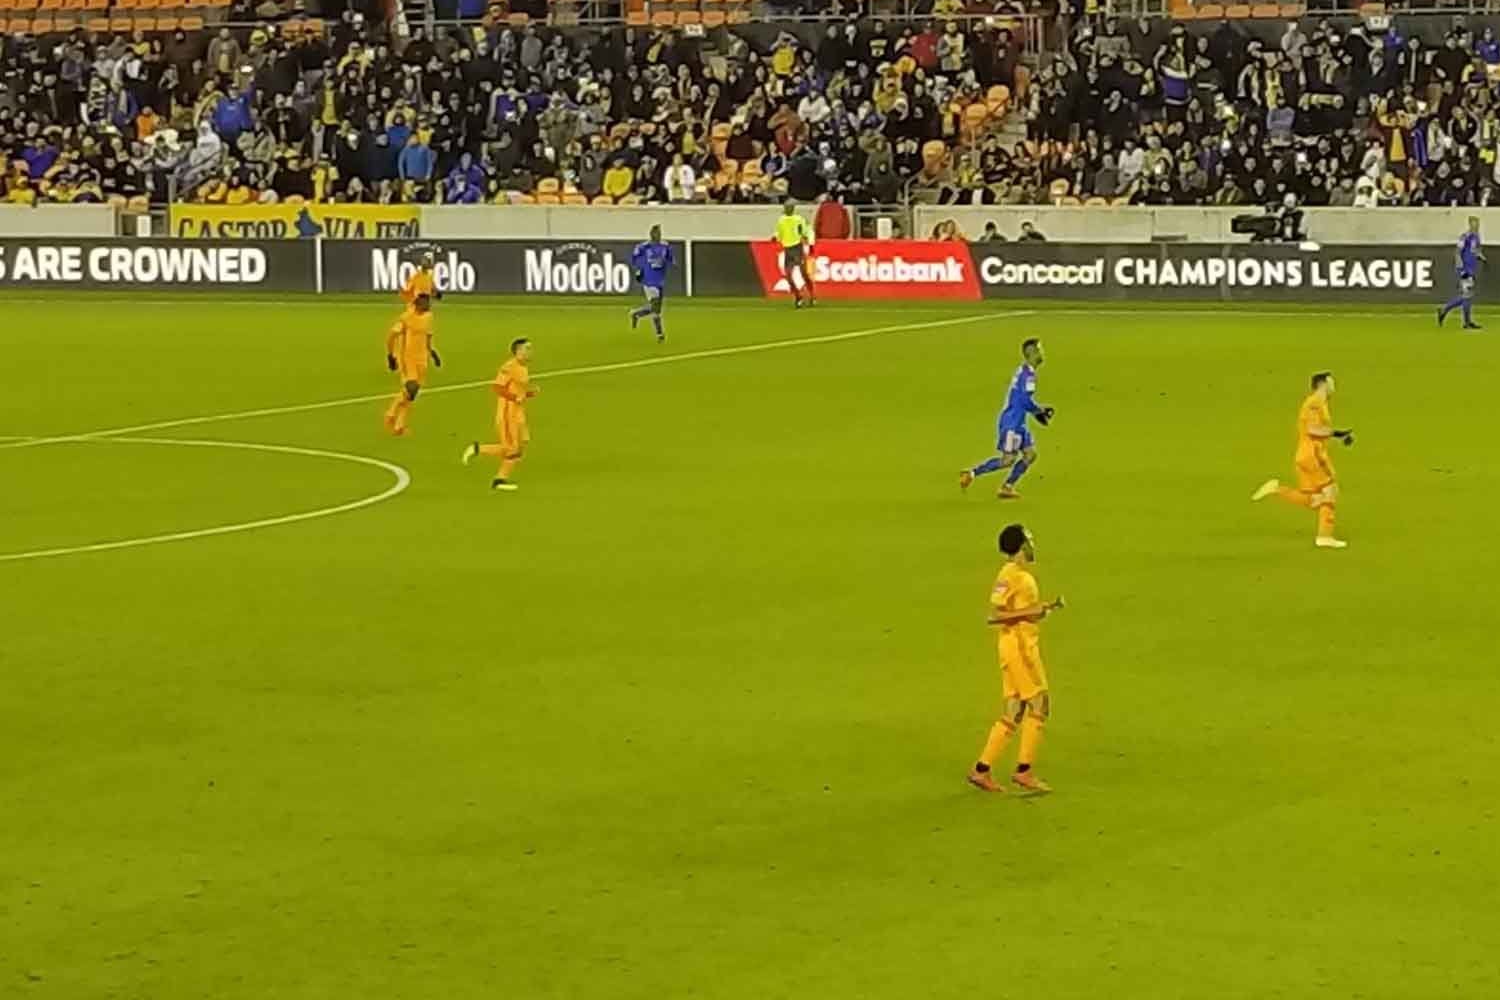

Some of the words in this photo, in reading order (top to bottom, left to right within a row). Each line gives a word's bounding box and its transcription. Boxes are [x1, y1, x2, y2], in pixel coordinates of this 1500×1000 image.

[12, 246, 83, 280] ARE
[88, 246, 267, 282] CROWNED
[371, 248, 476, 292] Moelo
[525, 249, 631, 293] Modelo
[812, 256, 963, 282] Scotiabank
[980, 257, 1105, 284] Concacaf
[1113, 257, 1303, 286] CHAMPIONS
[1310, 259, 1434, 288] LEAGUE
